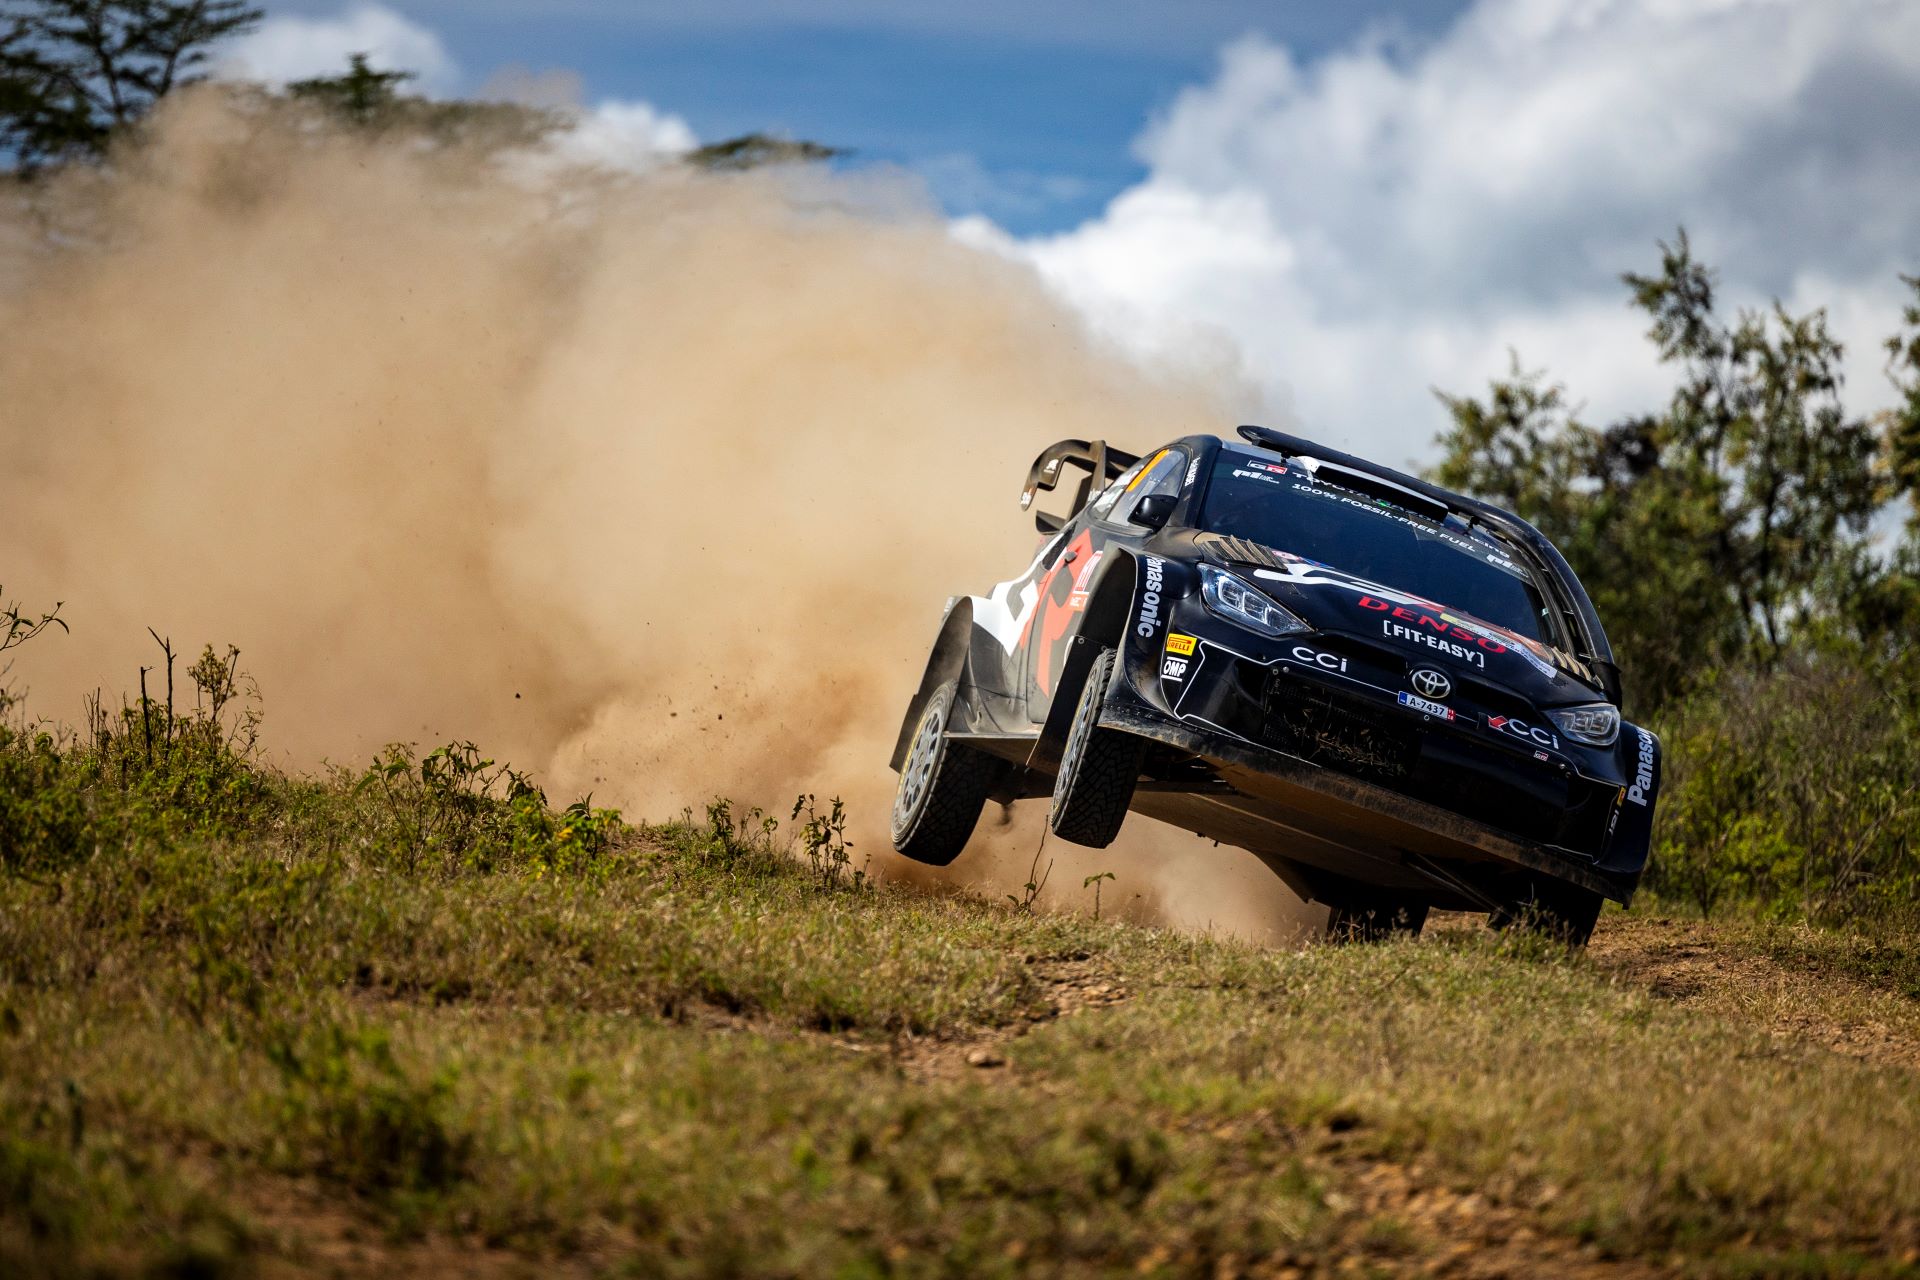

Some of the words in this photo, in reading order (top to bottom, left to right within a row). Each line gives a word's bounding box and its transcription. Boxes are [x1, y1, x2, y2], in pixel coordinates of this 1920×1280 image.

[1292, 483, 1337, 501] 100%
[1340, 497, 1437, 536] FOSSIL-FREE
[1439, 533, 1476, 552] FUEL
[1138, 555, 1166, 638] anasonic
[1358, 596, 1507, 654] DENSO
[1163, 659, 1187, 678] OMP
[1409, 697, 1445, 716] A-7437
